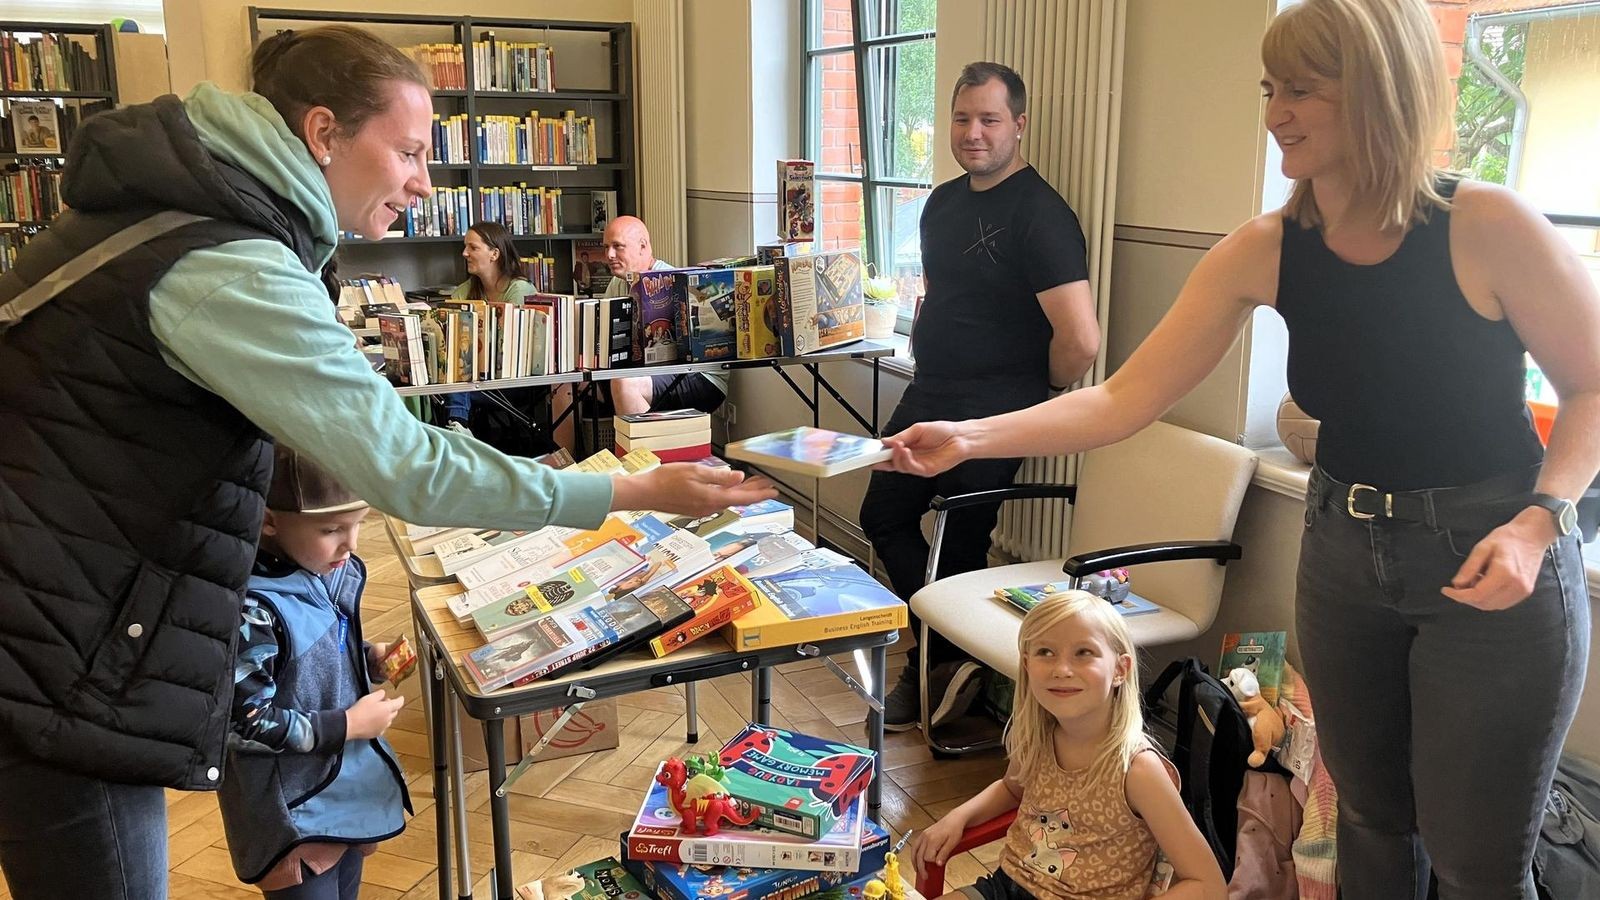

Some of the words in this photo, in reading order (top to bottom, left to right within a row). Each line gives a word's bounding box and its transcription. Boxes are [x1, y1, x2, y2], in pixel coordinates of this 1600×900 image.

[598, 608, 625, 636] EXODUS
[824, 625, 848, 633] Business
[850, 621, 870, 630] English
[871, 618, 892, 627] Training
[570, 649, 589, 662] JUMP
[587, 645, 597, 654] 22
[550, 657, 572, 670] STREET
[746, 750, 775, 768] GAME
[779, 761, 825, 776] MEMORY
[747, 767, 801, 787] LADYBUG
[648, 844, 672, 856] Trefl
